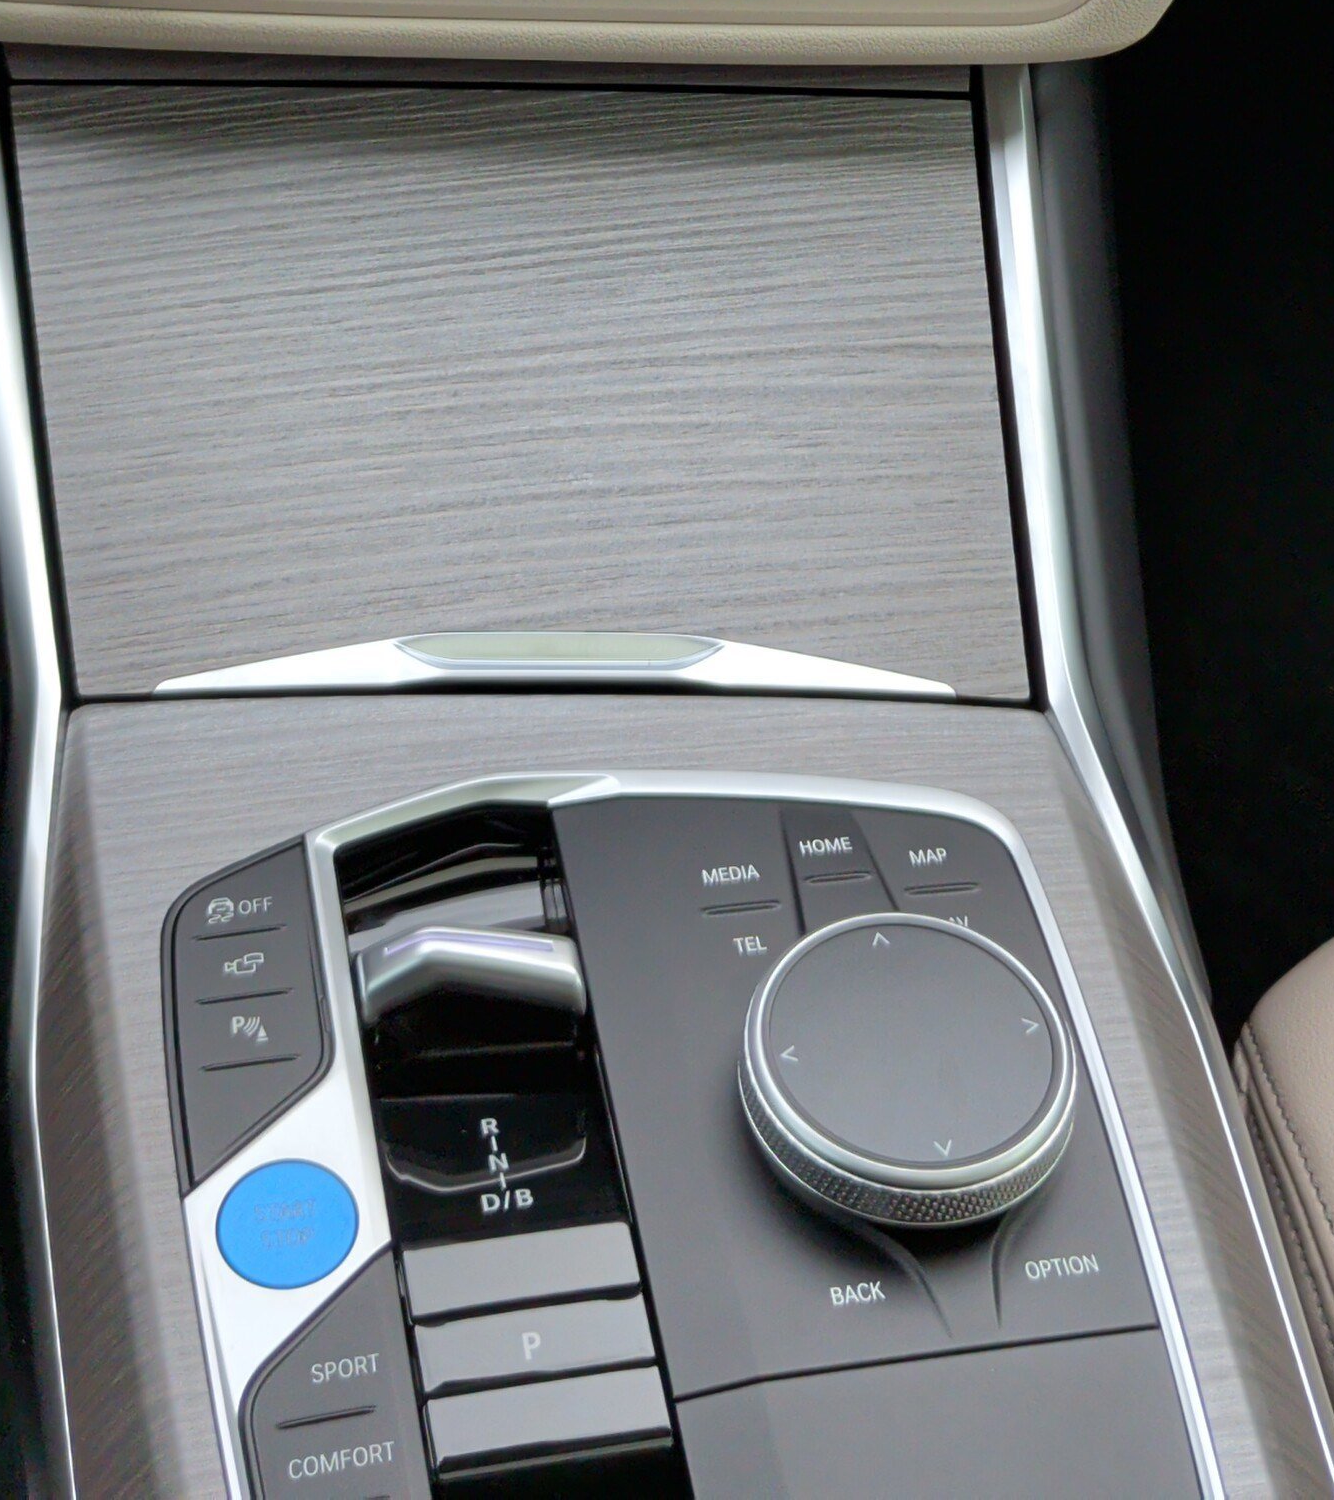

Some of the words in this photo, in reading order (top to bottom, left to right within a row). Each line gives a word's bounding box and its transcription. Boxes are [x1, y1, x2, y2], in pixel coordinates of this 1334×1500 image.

[799, 836, 853, 857] HOME
[908, 848, 948, 867] MAP
[701, 864, 761, 886] MEDIA
[238, 896, 273, 915] OFF
[733, 936, 768, 956] TEL
[480, 1117, 499, 1136] R
[489, 1152, 509, 1174] N
[480, 1188, 534, 1213] D/B
[1025, 1253, 1100, 1280] OPTION
[830, 1281, 886, 1307] BACK
[521, 1331, 542, 1360] P
[310, 1352, 380, 1383] SPORT
[288, 1441, 395, 1479] COMFORT
